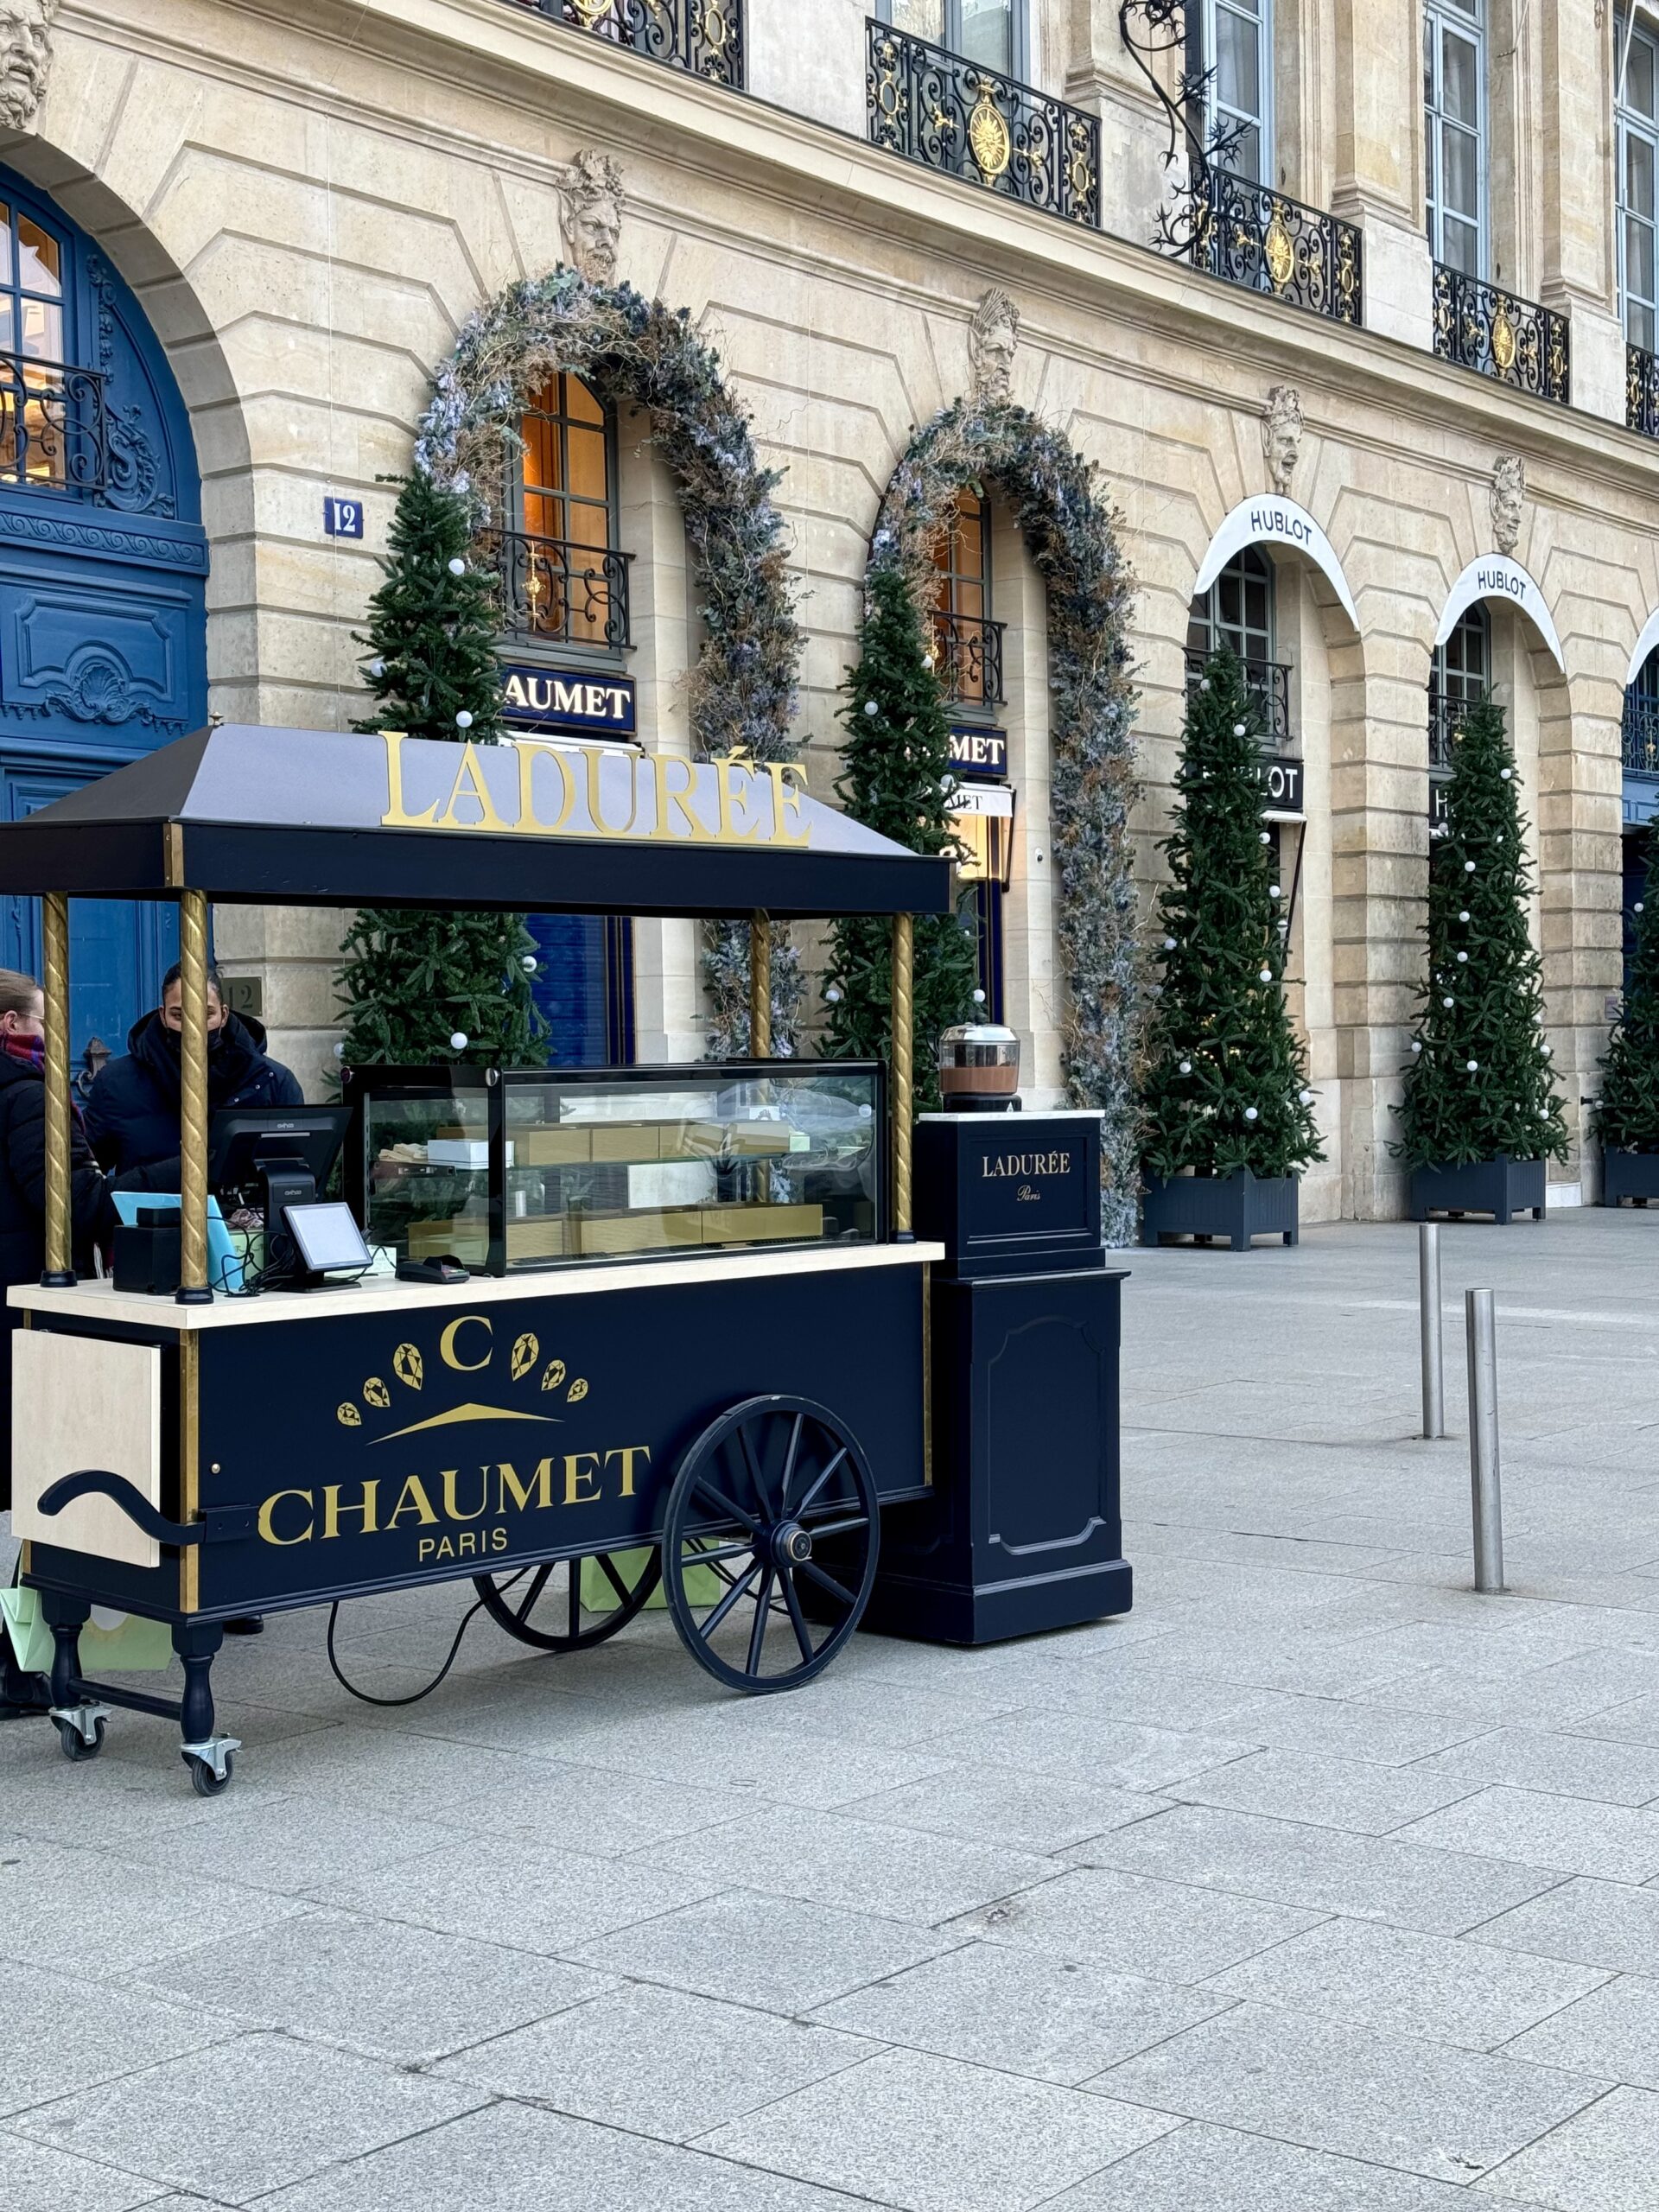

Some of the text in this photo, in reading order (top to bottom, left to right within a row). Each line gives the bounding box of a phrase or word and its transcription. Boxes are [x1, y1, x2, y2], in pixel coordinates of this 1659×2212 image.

[334, 503, 355, 532] 12
[1251, 510, 1312, 545] HUBLOT
[1478, 570, 1526, 600] HUBLOT
[494, 675, 631, 719] AUMET
[378, 731, 811, 847] LADURÉE
[228, 985, 253, 1009] 12
[982, 1150, 1071, 1177] LADURÉE
[1017, 1185, 1040, 1201] Paris
[440, 1315, 493, 1371] C
[257, 1446, 651, 1546] CHAUMET
[418, 1527, 508, 1561] PARIS
